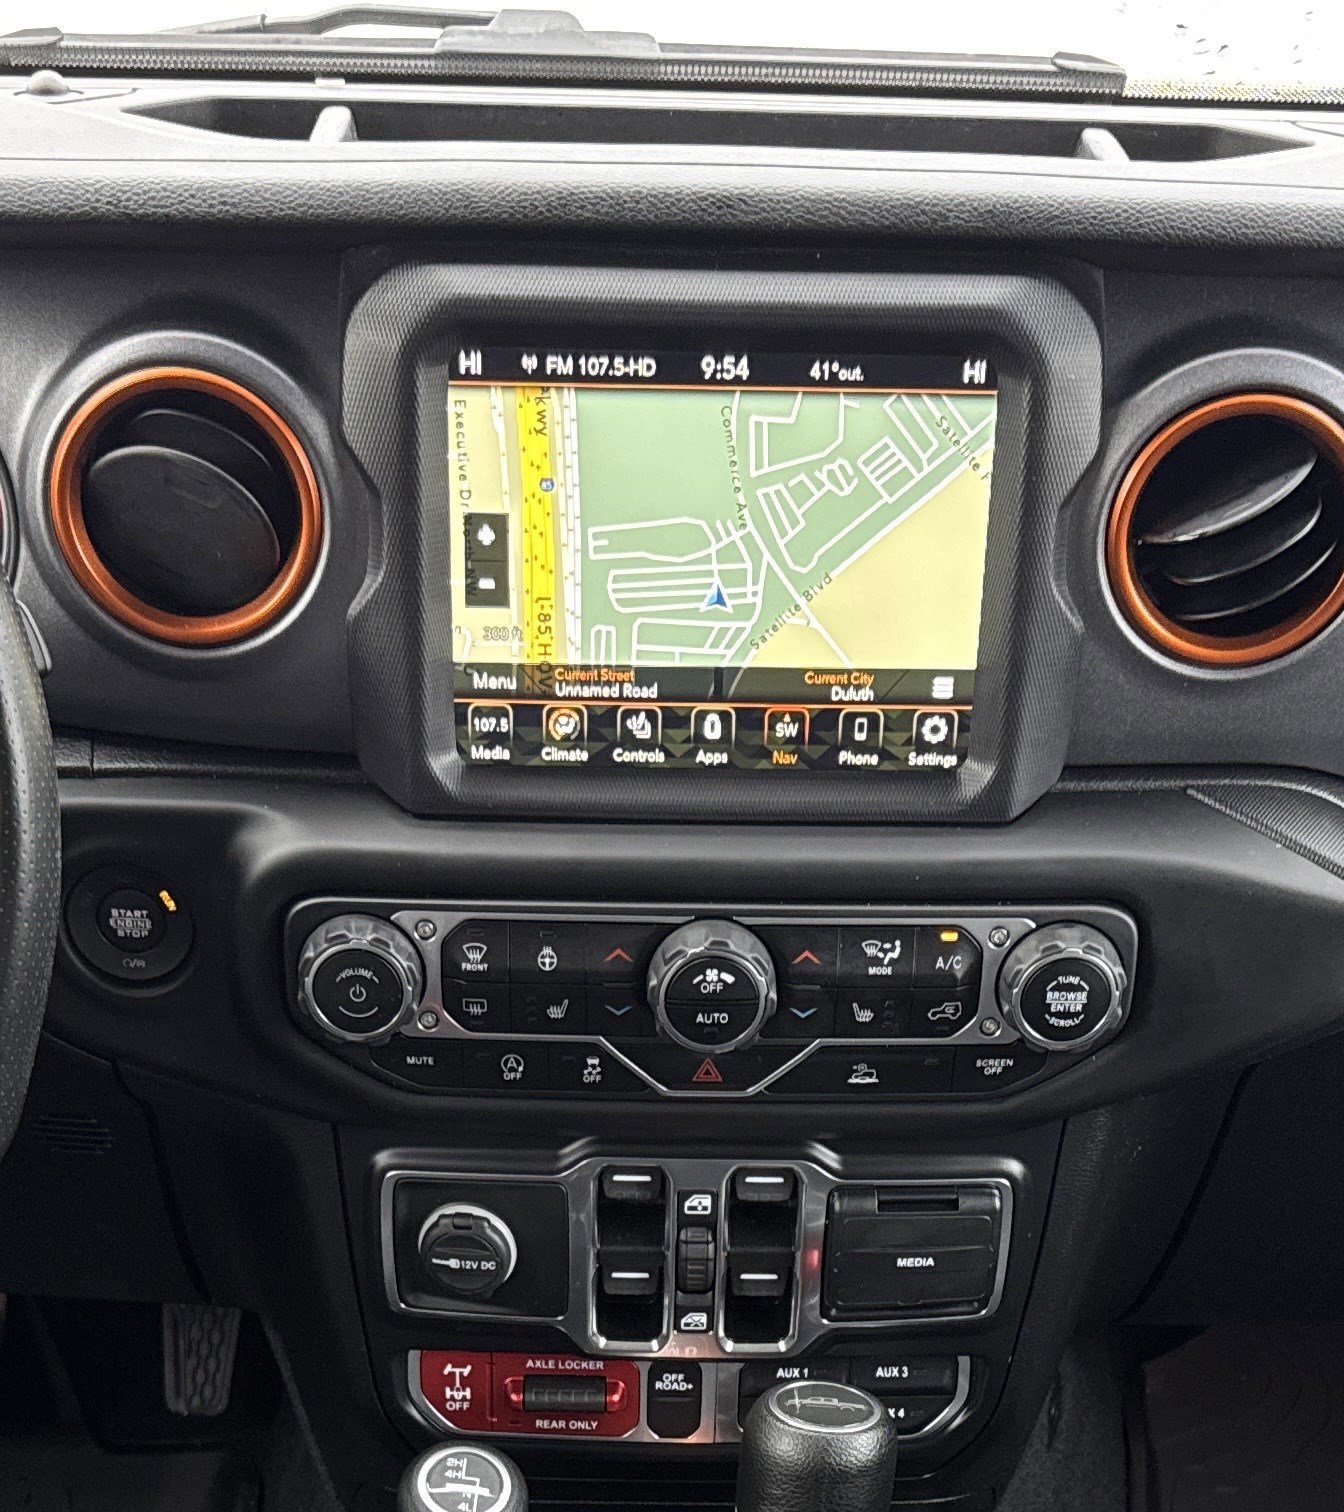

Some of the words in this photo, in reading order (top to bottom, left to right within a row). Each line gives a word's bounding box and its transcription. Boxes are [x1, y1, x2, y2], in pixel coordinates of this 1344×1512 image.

[458, 350, 482, 375] HI
[546, 354, 573, 376] FM
[578, 355, 657, 378] 107.5-HD
[701, 355, 749, 381] 9:54
[962, 359, 987, 384] HI
[454, 399, 469, 487] Executive
[935, 416, 981, 473] Satellite
[720, 405, 742, 495] Commerce
[736, 502, 748, 531] Ave
[458, 489, 472, 507] Dr
[750, 603, 802, 650] Satellite
[802, 572, 833, 602] Blvd
[483, 626, 509, 640] 300
[473, 672, 517, 690] Menu
[554, 668, 599, 683] Current
[601, 669, 635, 683] Street
[804, 671, 849, 685] Current
[850, 672, 875, 687] City
[555, 683, 620, 698] Unnamed
[622, 683, 658, 699] Road
[831, 686, 874, 702] Duluth
[473, 717, 508, 732] 107.5
[775, 723, 799, 738] SW
[471, 745, 510, 761] Media
[541, 746, 589, 762] Climate
[612, 748, 665, 763] Controls
[695, 750, 728, 765] Apps
[772, 751, 798, 765] Nav
[838, 751, 879, 766] Phone
[908, 752, 957, 768] Settings
[110, 908, 149, 918] START
[109, 918, 152, 929] ENGINE
[117, 929, 149, 938] STOP
[461, 962, 489, 972] FRONT
[935, 955, 963, 970] A/C
[341, 968, 374, 979] VOLUME
[868, 966, 893, 976] MODE
[1058, 975, 1081, 985] TUNE
[700, 982, 724, 994] OFF
[1046, 991, 1088, 1001] BROWSE
[1050, 1002, 1083, 1013] ENTER
[695, 1013, 729, 1025] AUTO
[1048, 1016, 1081, 1028] SCROLL
[406, 1056, 434, 1066] MUTE
[975, 1058, 1014, 1068] SCREEN
[503, 1071, 523, 1081] OFF
[983, 1066, 1003, 1076] OFF
[582, 1073, 602, 1084] OFF
[460, 1260, 479, 1270] 12V
[480, 1261, 497, 1271] DC
[896, 1257, 935, 1267] MEDIA
[525, 1359, 556, 1370] AXLE
[558, 1359, 604, 1370] LOCKER
[662, 1373, 685, 1382] OFF
[776, 1367, 800, 1379] AUX
[803, 1367, 809, 1379] 1
[875, 1366, 900, 1378] AUX
[901, 1366, 909, 1378] 3
[655, 1381, 694, 1392] ROAD+
[445, 1401, 471, 1411] OFF
[535, 1419, 567, 1430] REAR
[568, 1420, 599, 1431] ONLY
[446, 1457, 463, 1467] 2H
[444, 1469, 463, 1479] 4H
[457, 1502, 473, 1512] 4L
